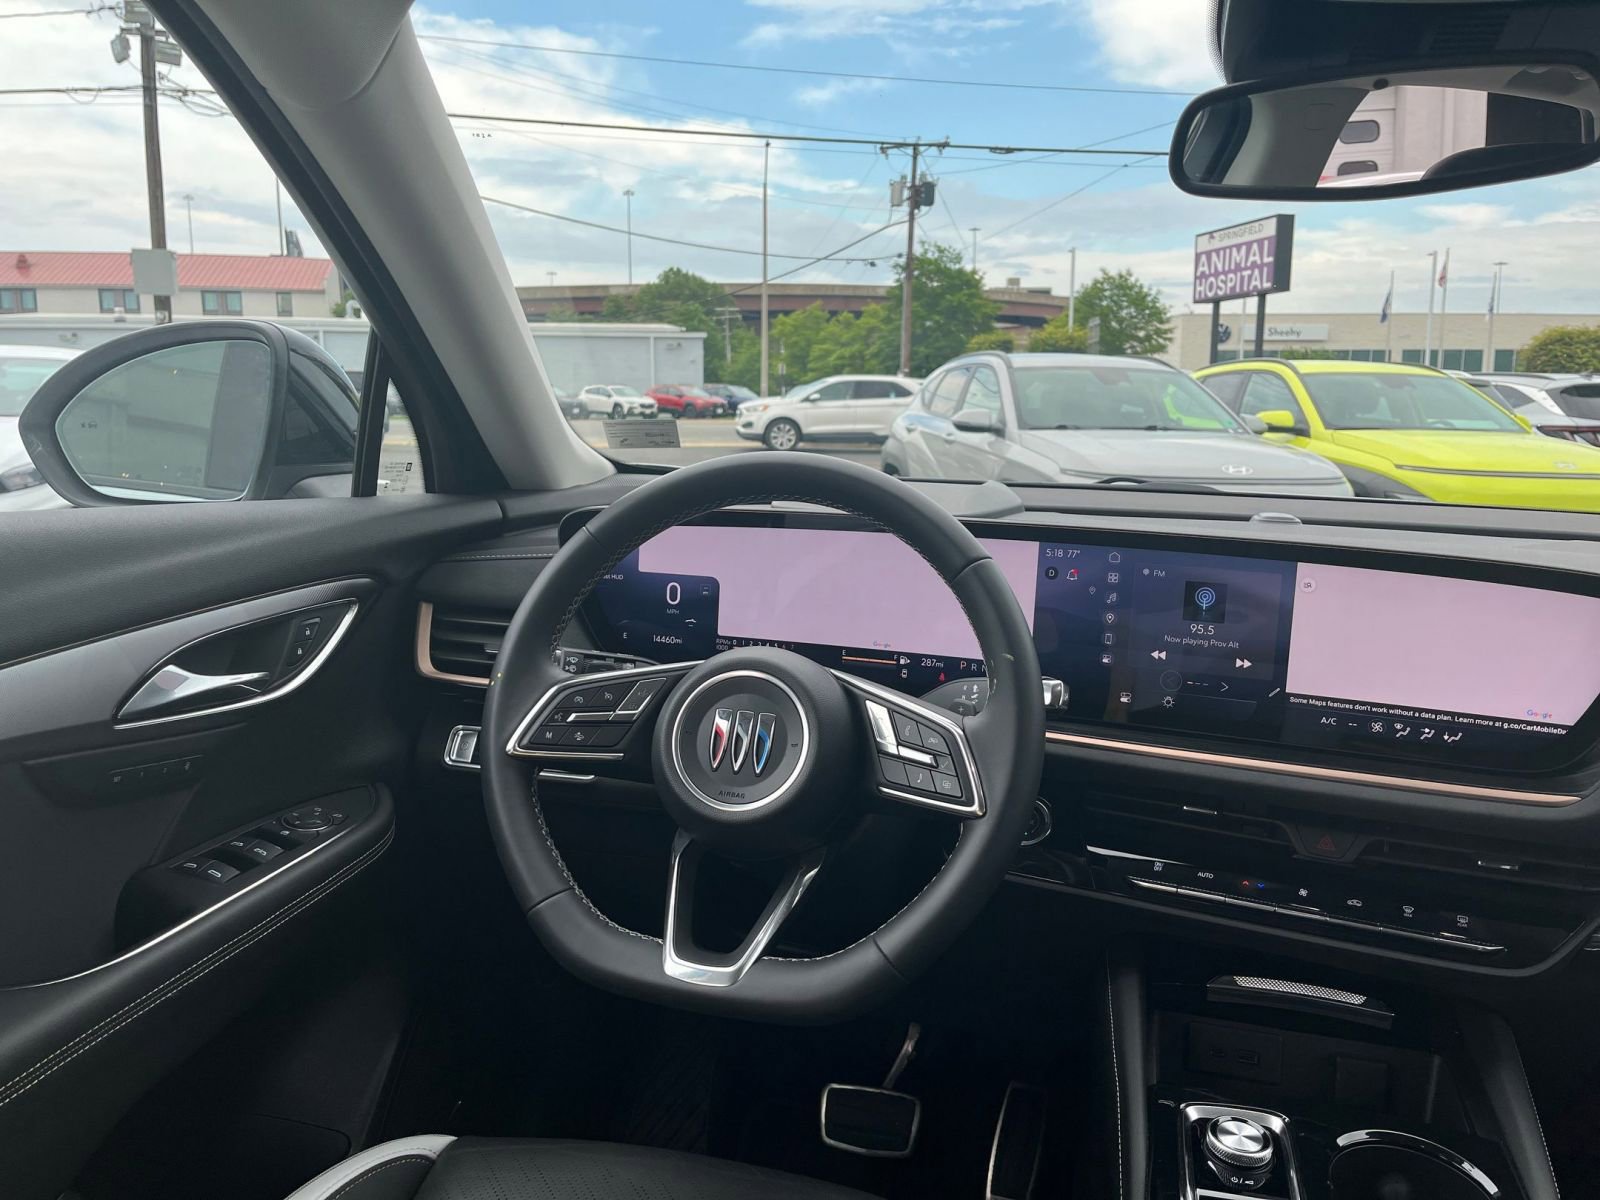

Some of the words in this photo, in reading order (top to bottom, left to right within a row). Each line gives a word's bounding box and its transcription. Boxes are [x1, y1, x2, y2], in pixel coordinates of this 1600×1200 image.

[1219, 223, 1264, 242] SPRINGFIELD
[1196, 240, 1274, 276] ANIMAL
[1195, 267, 1271, 299] HOSPITAL
[1267, 326, 1303, 338] Sheehy
[1045, 548, 1063, 558] 5:18
[1067, 549, 1080, 558] 77°
[1048, 569, 1055, 577] D
[667, 582, 681, 605] 0
[1190, 623, 1215, 635] 95.5
[1164, 634, 1181, 643] Now
[1182, 637, 1209, 647] playing
[1210, 639, 1227, 647] Prov
[960, 661, 967, 670] P
[971, 663, 977, 671] R
[1289, 696, 1307, 704] Some
[1328, 701, 1353, 709] features
[1389, 708, 1414, 716] without
[1526, 709, 1552, 719] Goge
[1320, 716, 1337, 725] A/C
[719, 790, 745, 799] AIRBAG
